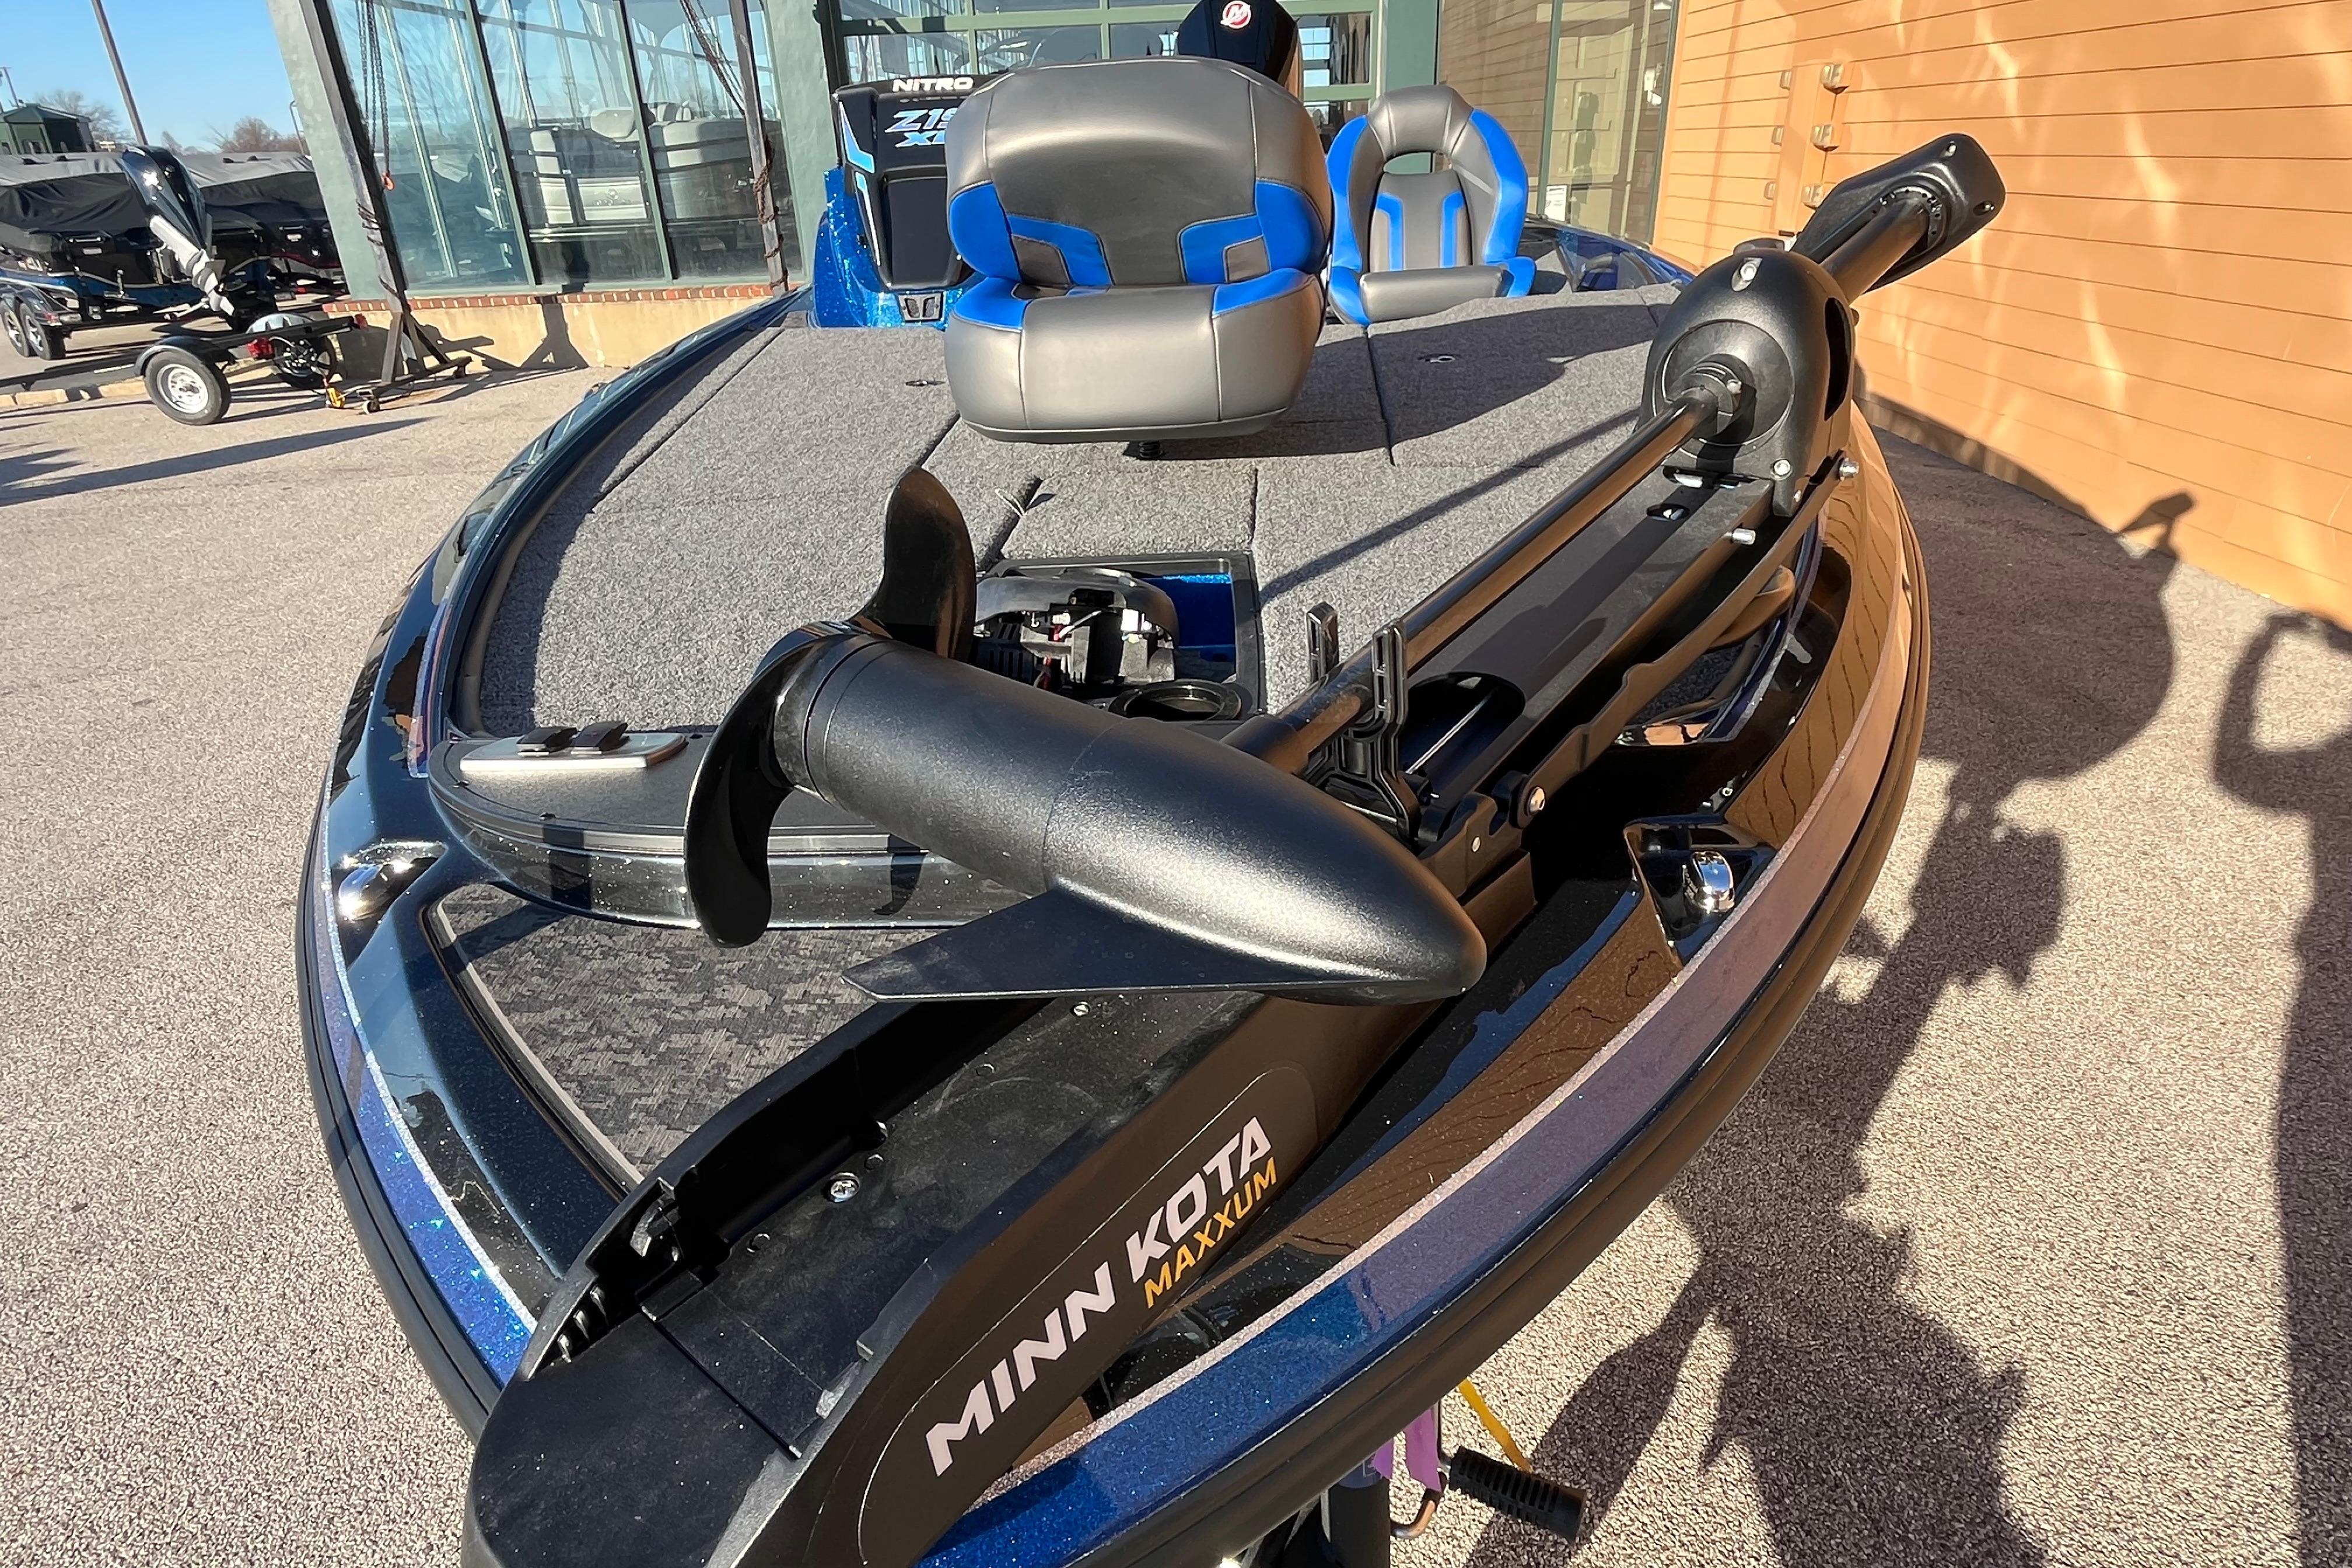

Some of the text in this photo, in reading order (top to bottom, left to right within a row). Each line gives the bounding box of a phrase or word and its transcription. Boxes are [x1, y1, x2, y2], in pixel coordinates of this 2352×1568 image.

[892, 77, 974, 92] NITRO
[925, 1116, 1272, 1477] MINN KOTA
[1144, 1157, 1278, 1308] MAXXUM
